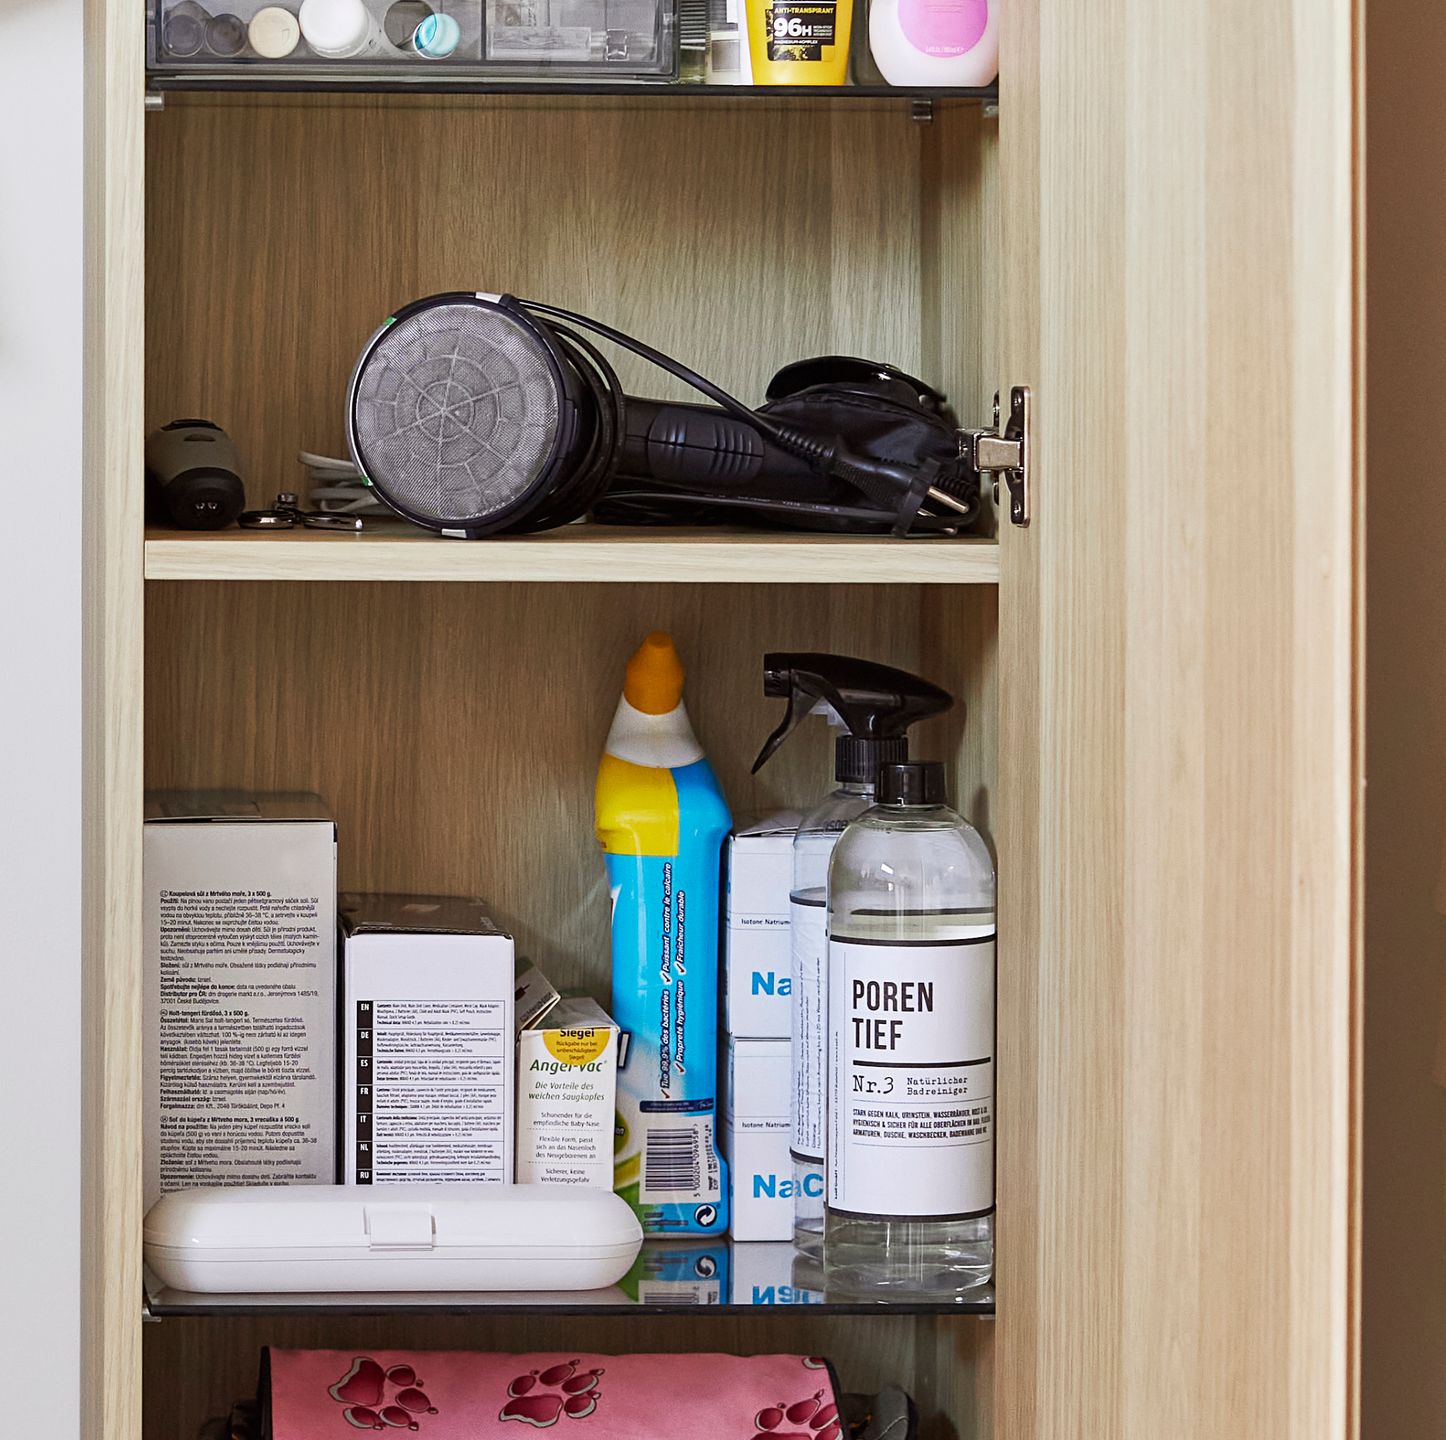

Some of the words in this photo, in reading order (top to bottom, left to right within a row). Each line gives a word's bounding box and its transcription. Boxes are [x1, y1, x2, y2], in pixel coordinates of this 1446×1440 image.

[773, 18, 812, 37] 96H
[664, 863, 672, 895] calcaire
[663, 897, 671, 905] le
[677, 891, 685, 923] durable
[663, 907, 671, 933] contre
[676, 924, 685, 962] Fraîcheur
[676, 981, 685, 1025] hygiénique
[853, 980, 933, 1012] POREN
[662, 990, 670, 1028] bactéries
[852, 1017, 903, 1050] TIEF
[676, 1027, 685, 1062] Propreté
[535, 1082, 548, 1090] Die
[550, 1082, 579, 1090] Vorteile
[583, 1082, 594, 1090] des
[853, 1075, 894, 1094] Nr.3
[907, 1077, 968, 1086] Natürlicher
[529, 1092, 560, 1100] weichen
[561, 1092, 605, 1102] Saugkopfes
[907, 1087, 968, 1096] Badreiniger
[868, 1109, 884, 1117] GEGEN
[885, 1110, 900, 1118] KALK,
[920, 1121, 932, 1129] ALLE
[541, 1176, 589, 1184] Verletzungsgefahr
